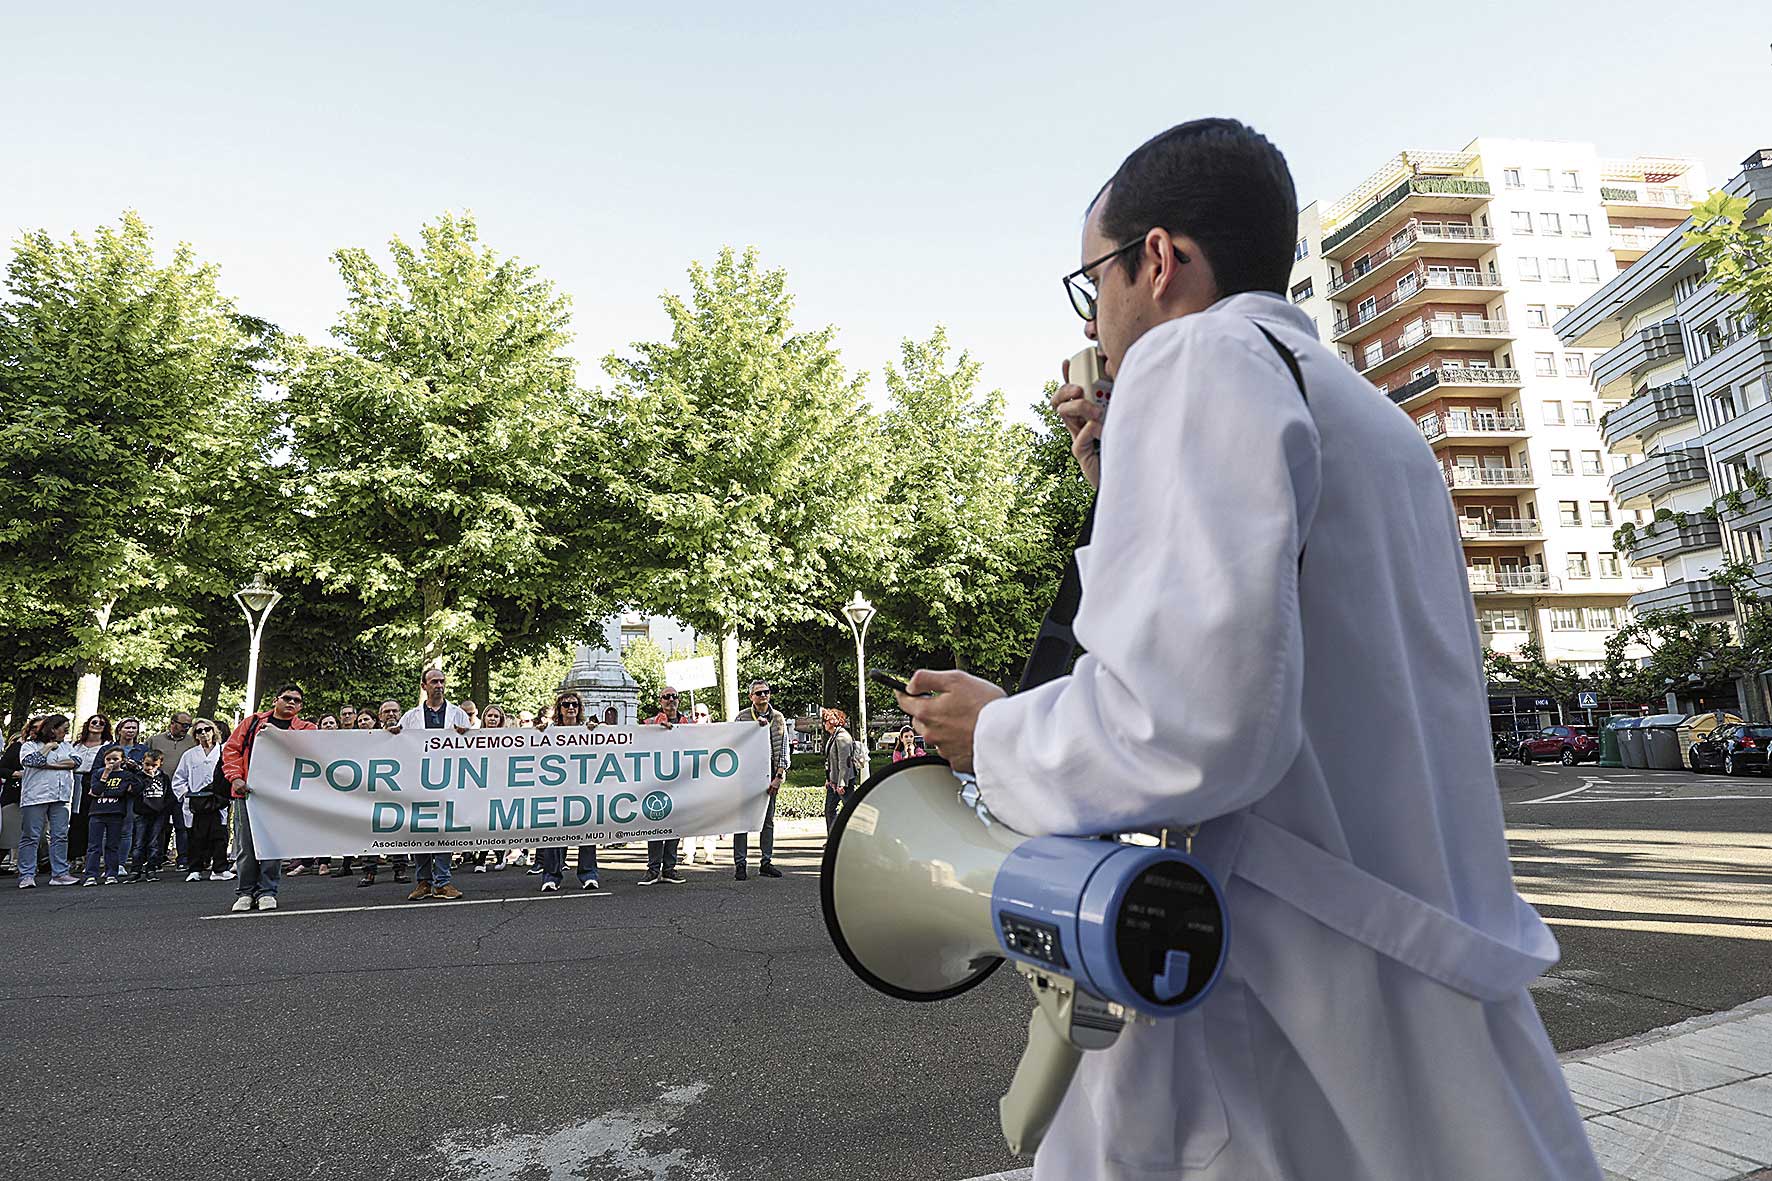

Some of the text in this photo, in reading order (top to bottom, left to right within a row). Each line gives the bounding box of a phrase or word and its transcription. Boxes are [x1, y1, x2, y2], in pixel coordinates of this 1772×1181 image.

[424, 733, 633, 752] ¡SALVEMOS LA SANIDAD!
[290, 748, 739, 792] POR UN ESTATUTO
[372, 801, 471, 833] DEL
[371, 839, 422, 848] Asociación
[437, 839, 474, 847] Médicos
[476, 837, 506, 846] Unidos
[508, 838, 523, 846] por
[585, 831, 605, 840] MUD
[615, 827, 673, 839] @mudmedicos
